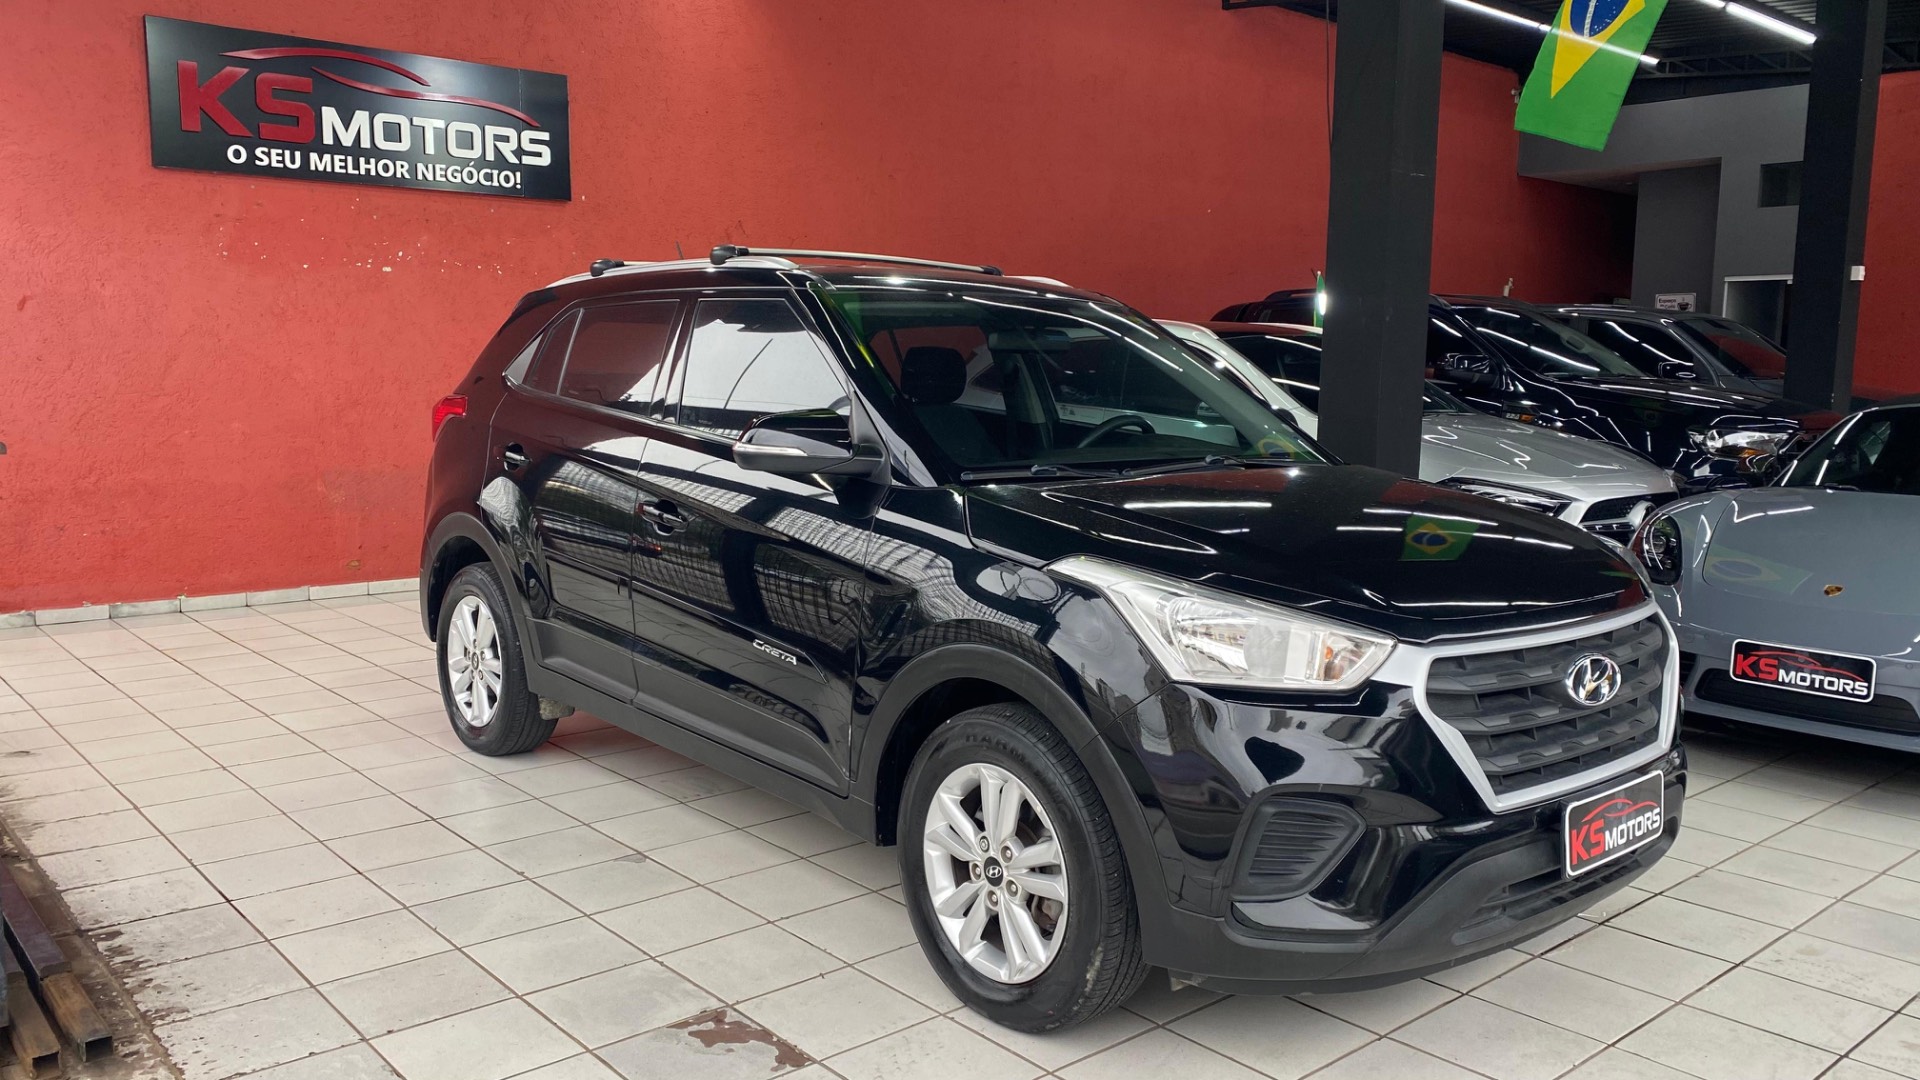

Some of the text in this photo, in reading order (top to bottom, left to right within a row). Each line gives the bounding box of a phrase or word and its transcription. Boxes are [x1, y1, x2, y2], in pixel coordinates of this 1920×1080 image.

[177, 60, 551, 166] KS MOTORS
[227, 144, 521, 189] O SEU MELHOR NEGÓCIO!
[752, 639, 797, 665] CRETA
[1735, 653, 1868, 696] KS MOTORS
[1571, 807, 1661, 865] KS MOTORS
